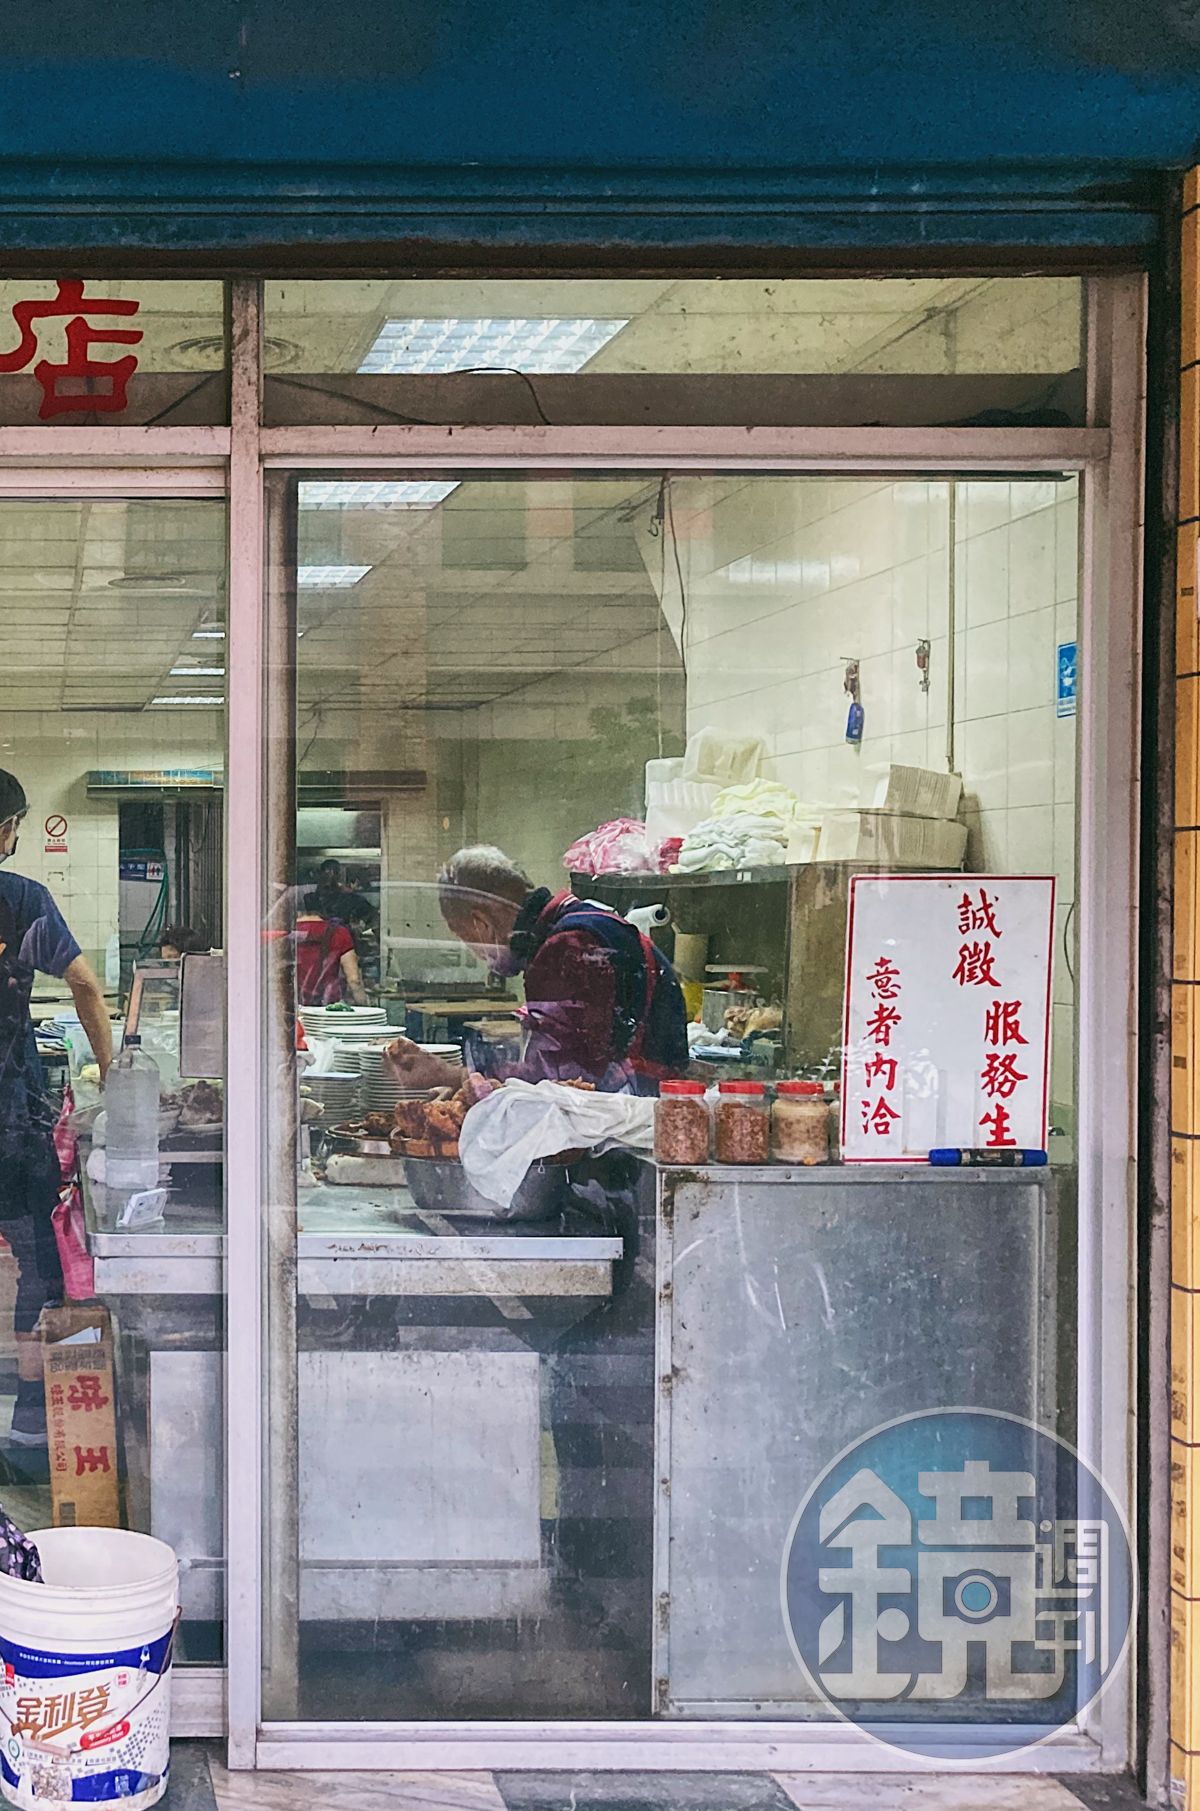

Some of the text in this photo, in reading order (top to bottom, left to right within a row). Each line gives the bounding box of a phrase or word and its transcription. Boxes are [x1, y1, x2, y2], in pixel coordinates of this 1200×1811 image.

[952, 887, 1004, 988] 誠徵
[861, 956, 902, 1136] 意者內洽
[978, 1000, 1030, 1148] 服務生
[67, 1374, 111, 1478] 味王
[11, 1682, 117, 1741] 金利登
